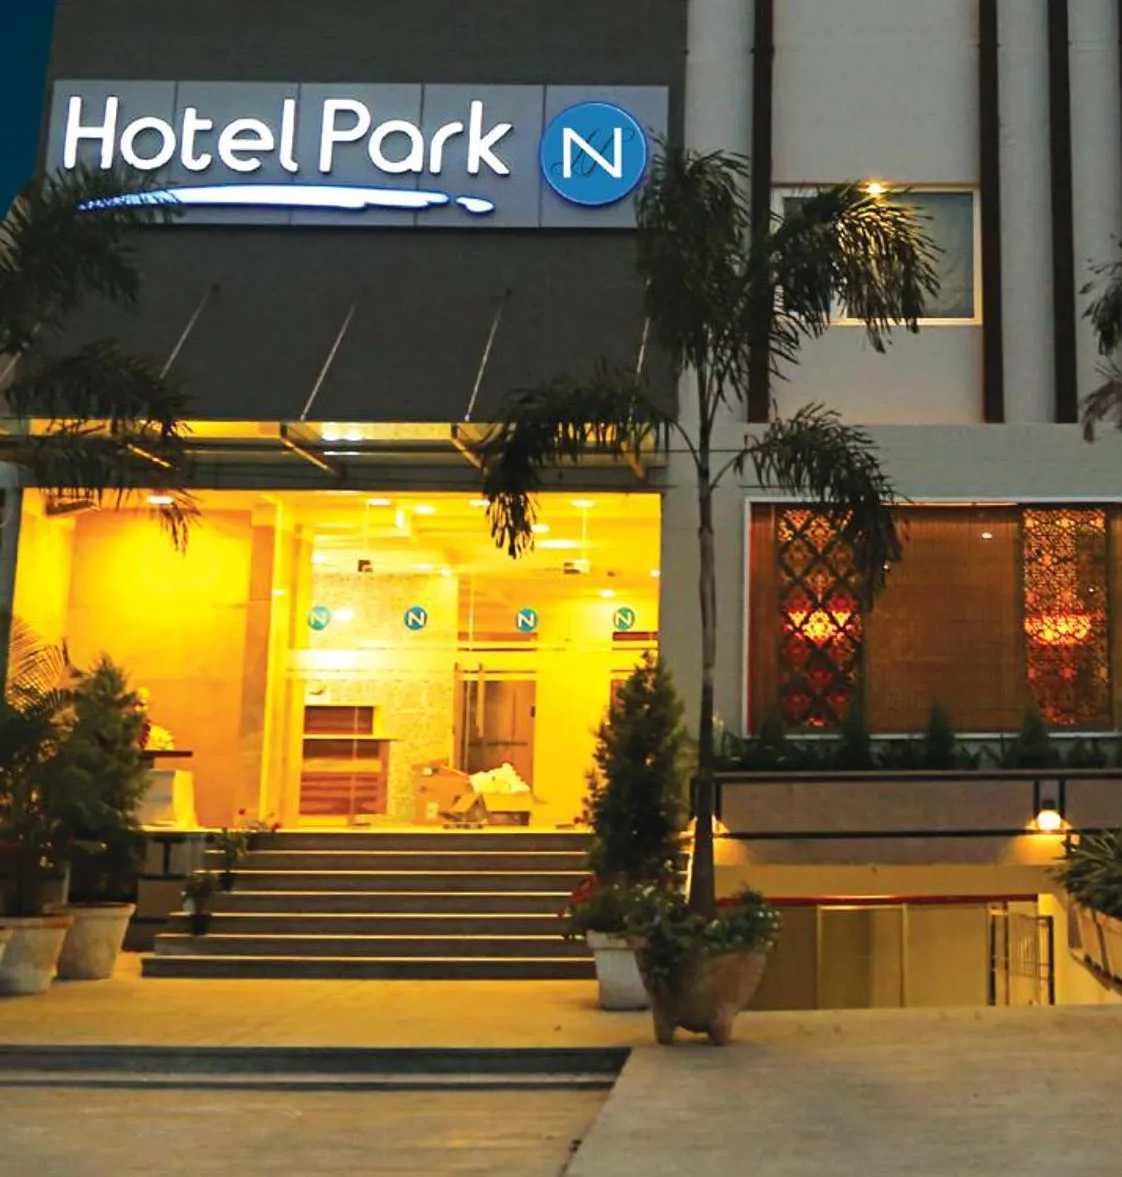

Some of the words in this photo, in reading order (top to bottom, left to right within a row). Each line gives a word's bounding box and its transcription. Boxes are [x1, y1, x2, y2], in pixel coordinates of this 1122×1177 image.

[63, 95, 298, 172] Hotel
[318, 99, 513, 175] Park
[563, 127, 622, 178] N
[407, 611, 425, 626] N
[517, 612, 535, 628] N
